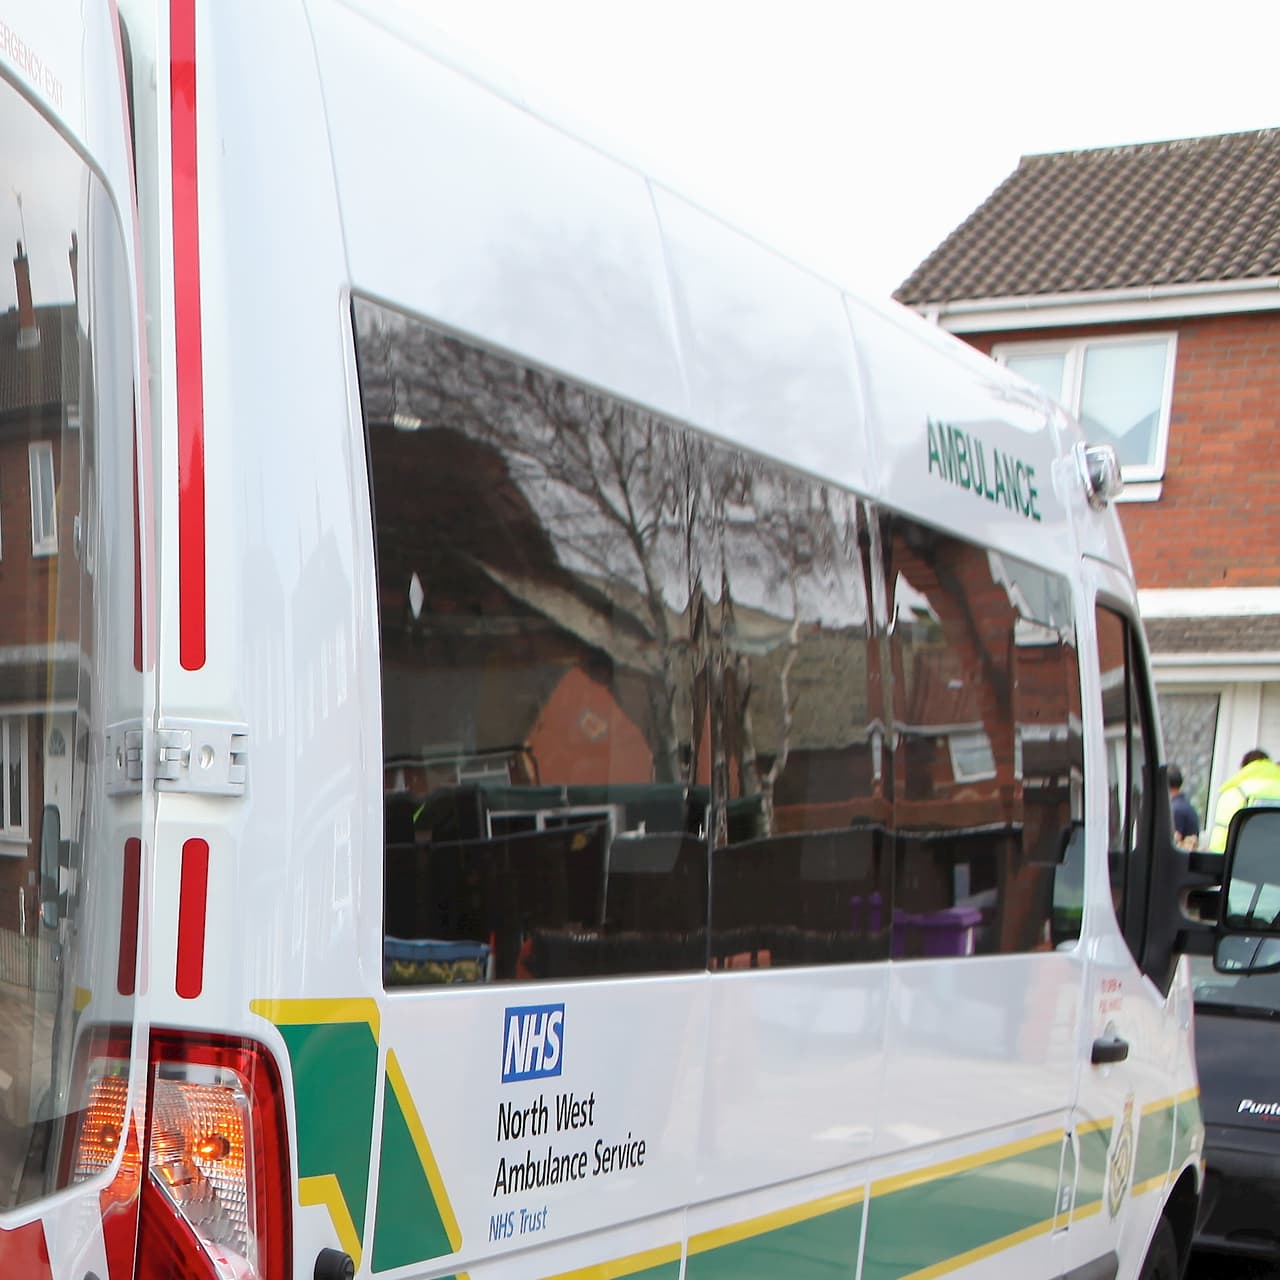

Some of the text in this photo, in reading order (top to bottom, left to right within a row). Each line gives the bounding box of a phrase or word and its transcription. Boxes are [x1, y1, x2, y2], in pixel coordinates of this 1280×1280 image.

[44, 64, 63, 109] EXIT
[928, 414, 1041, 522] AMBULANCE
[503, 1010, 564, 1076] NHS
[497, 1092, 596, 1142] North West
[493, 1132, 646, 1197] Ambulance Service
[489, 1205, 549, 1242] NHS Trust
